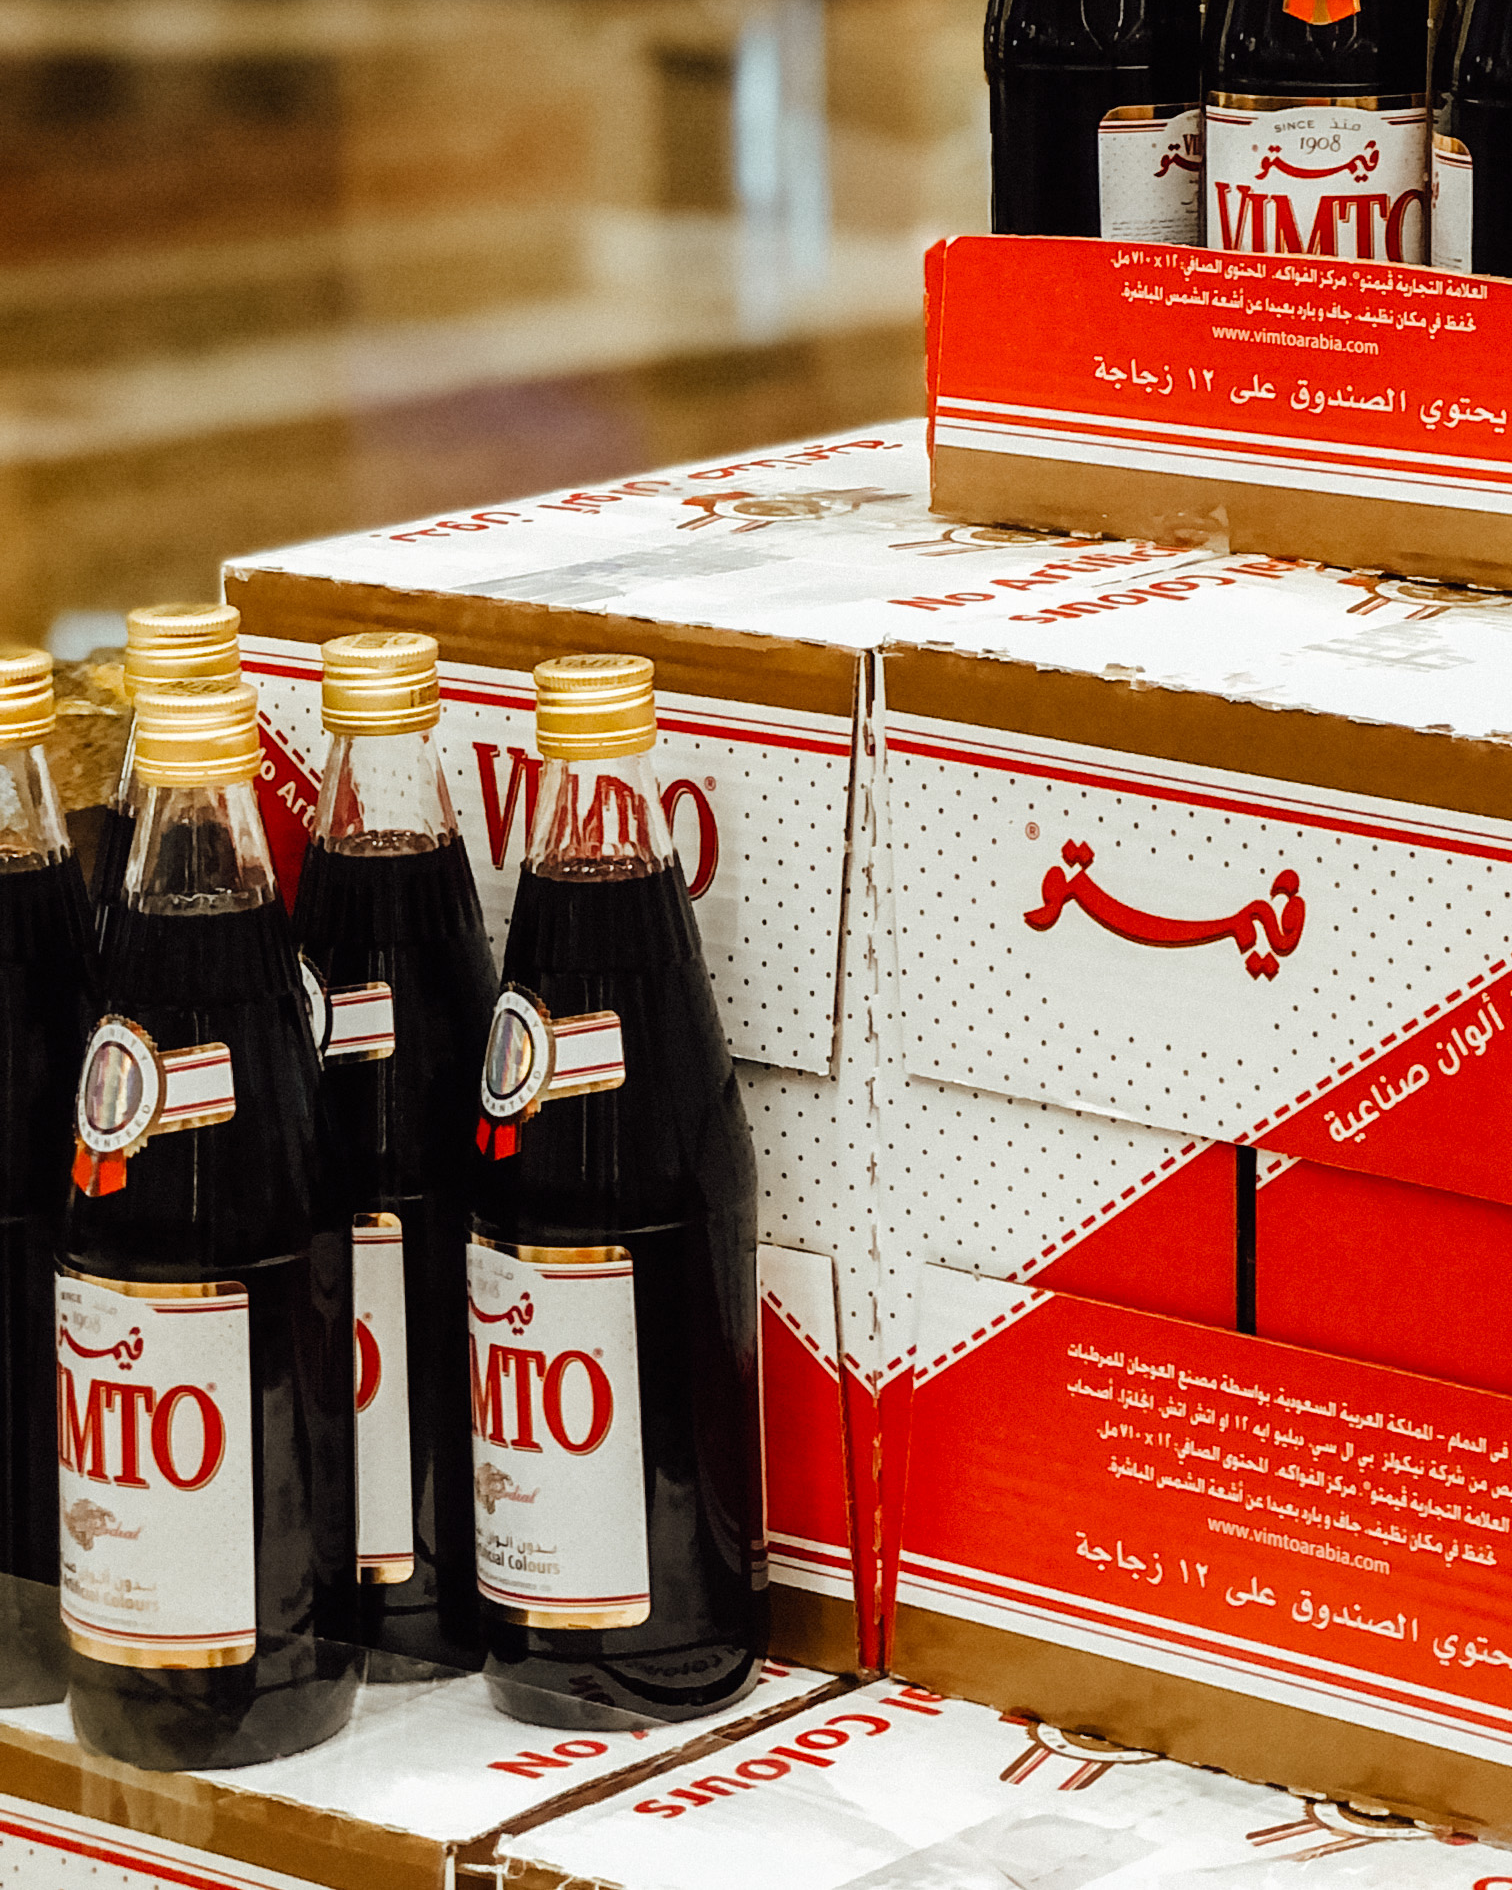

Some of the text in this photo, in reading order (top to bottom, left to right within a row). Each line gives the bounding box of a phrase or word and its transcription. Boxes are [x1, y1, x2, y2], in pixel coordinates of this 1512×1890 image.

[1274, 119, 1315, 133] SINCE
[1299, 135, 1341, 153] 1908
[1165, 287, 1210, 306] الشمس
[1245, 299, 1263, 314] عن
[1396, 311, 1427, 329] مكان
[1428, 312, 1442, 339] في
[1212, 325, 1379, 355] www.vimtoarabia.com
[1093, 356, 1508, 433] يحتوي الصندوق على ١٢ زجاجة
[887, 591, 995, 611] No
[990, 543, 1192, 591] Artifici
[1009, 574, 1236, 624] Colours
[1024, 838, 1306, 983] فيمتو
[1436, 992, 1505, 1076] ألوان
[1323, 1063, 1431, 1144] صناعية
[1067, 1343, 1124, 1368] للمرطبات
[1127, 1356, 1174, 1380] العوجان
[1178, 1369, 1217, 1390] مصنع
[1220, 1374, 1270, 1407] بواسطة
[470, 1342, 614, 1456] MTO
[1339, 1402, 1383, 1429] العربية
[1386, 1413, 1433, 1440] المملكة
[1447, 1432, 1487, 1453] الدمام
[1156, 1471, 1206, 1494] الشمس
[1326, 1475, 1357, 1498] مركز
[1428, 1460, 1465, 1487] شركة
[1468, 1476, 1488, 1493] من
[1208, 1478, 1243, 1502] أشعة
[1245, 1494, 1264, 1511] عن
[1333, 1510, 1362, 1537] جاف
[1207, 1516, 1391, 1576] www.vimtoarabia.com
[1409, 1532, 1443, 1554] مكان
[1444, 1538, 1459, 1569] في
[508, 1555, 561, 1575] Colours
[1075, 1531, 1164, 1585] زجاجة
[1179, 1558, 1209, 1589] ١٢
[1225, 1575, 1277, 1608] على
[1290, 1589, 1419, 1643] الصندوق
[487, 1738, 609, 1780] No
[632, 1713, 892, 1820] Colours
